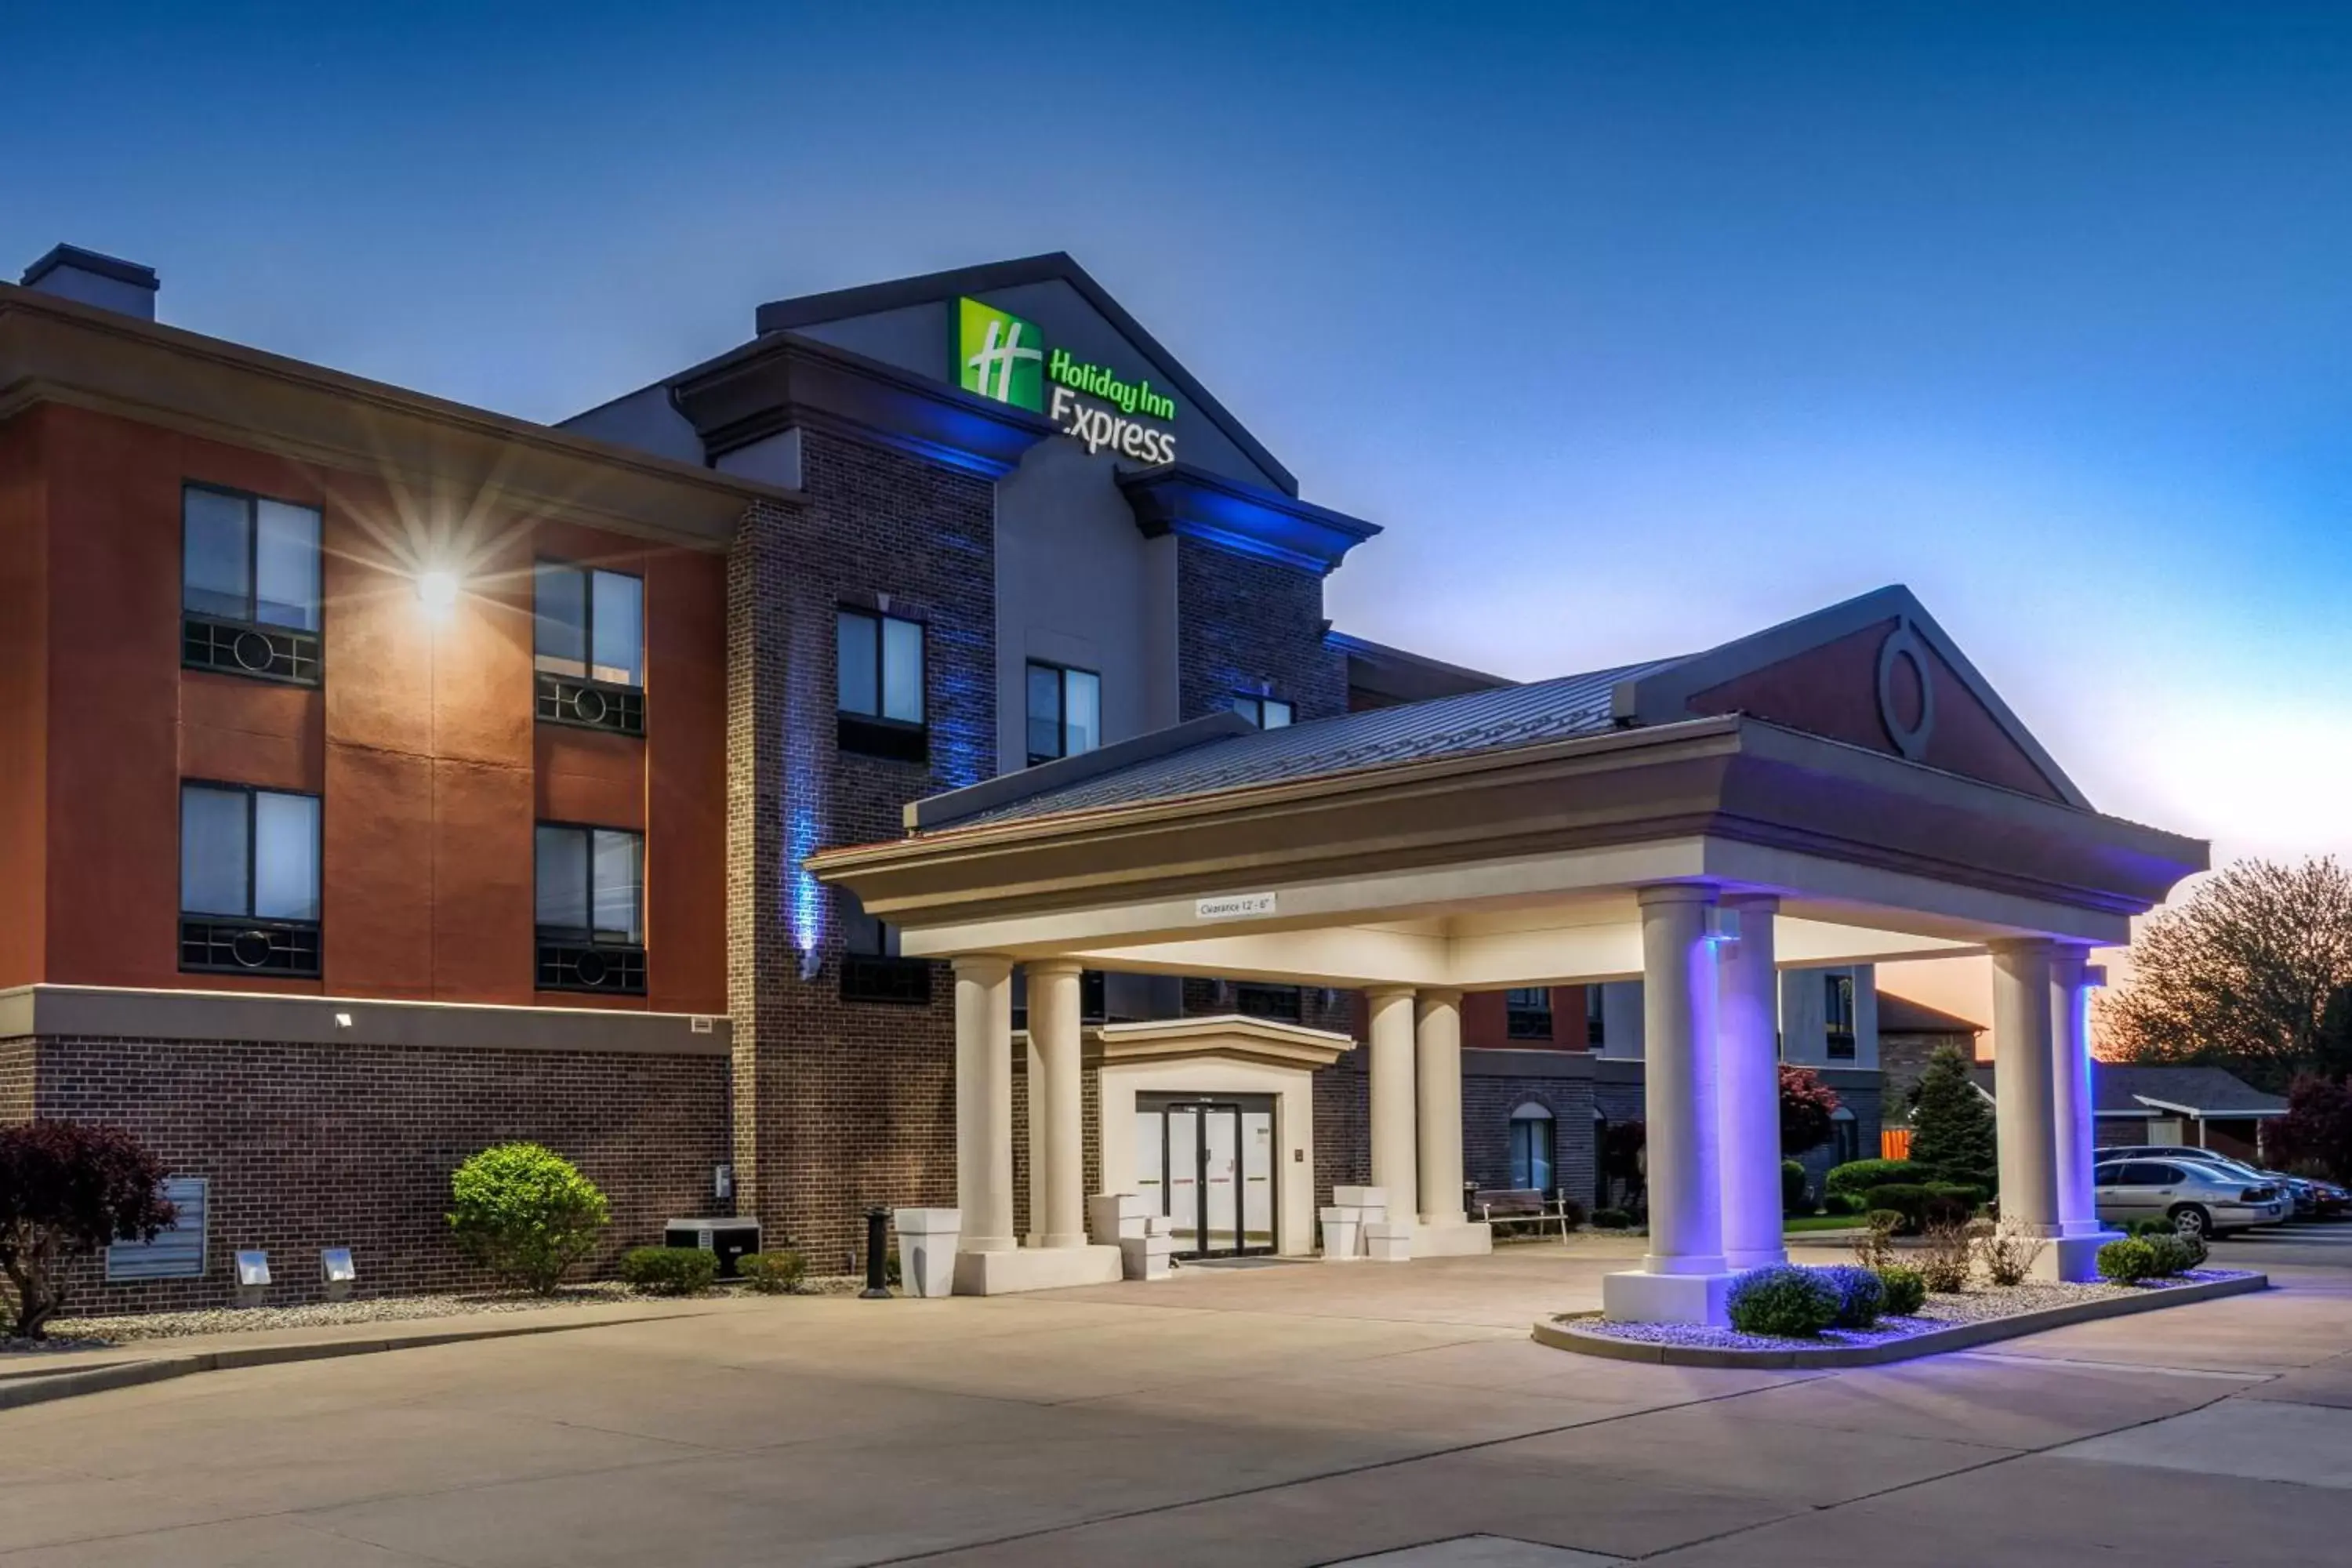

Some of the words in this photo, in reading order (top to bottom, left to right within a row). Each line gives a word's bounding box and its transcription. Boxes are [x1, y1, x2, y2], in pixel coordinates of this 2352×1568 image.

[1050, 349, 1138, 414] Holiday
[1140, 380, 1174, 420] Inn
[1051, 386, 1176, 464] Express
[1200, 902, 1240, 914] Clearance
